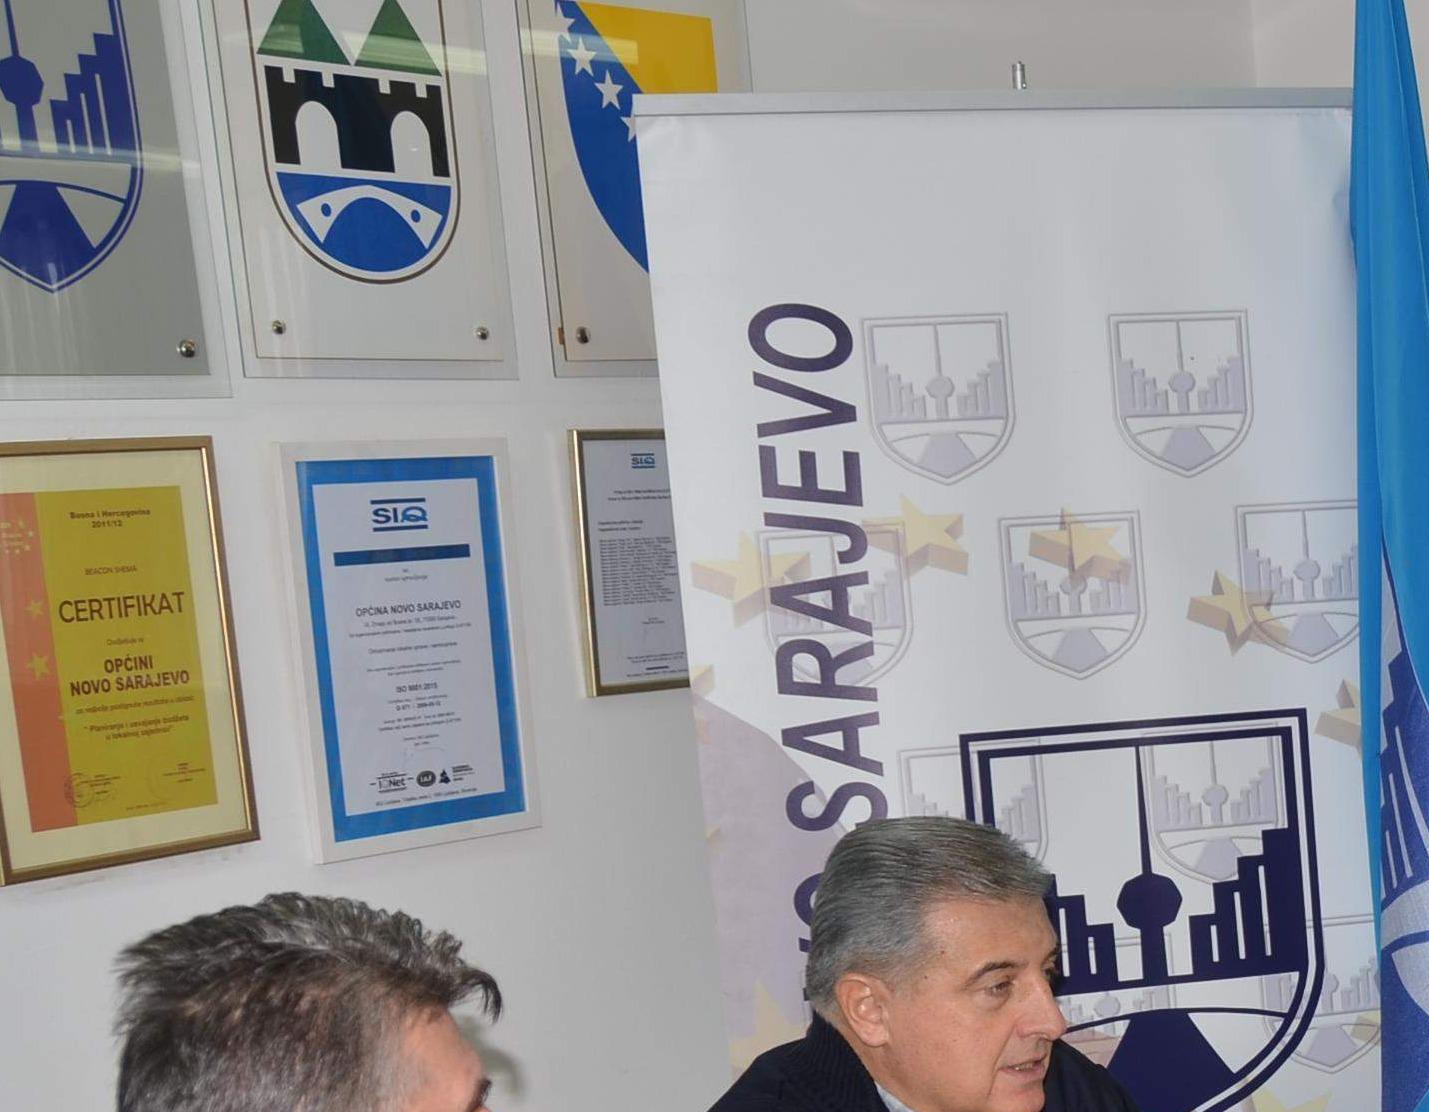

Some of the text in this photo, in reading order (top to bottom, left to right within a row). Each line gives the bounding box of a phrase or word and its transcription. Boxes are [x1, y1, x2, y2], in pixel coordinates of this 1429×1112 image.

[371, 506, 428, 524] SIQ
[747, 302, 889, 832] SARAJEVO
[59, 591, 185, 623] CERTIFIKAT
[390, 603, 416, 614] NOVO
[417, 600, 461, 612] SARAJEVO
[70, 670, 190, 697] NOVO SARAJEVO
